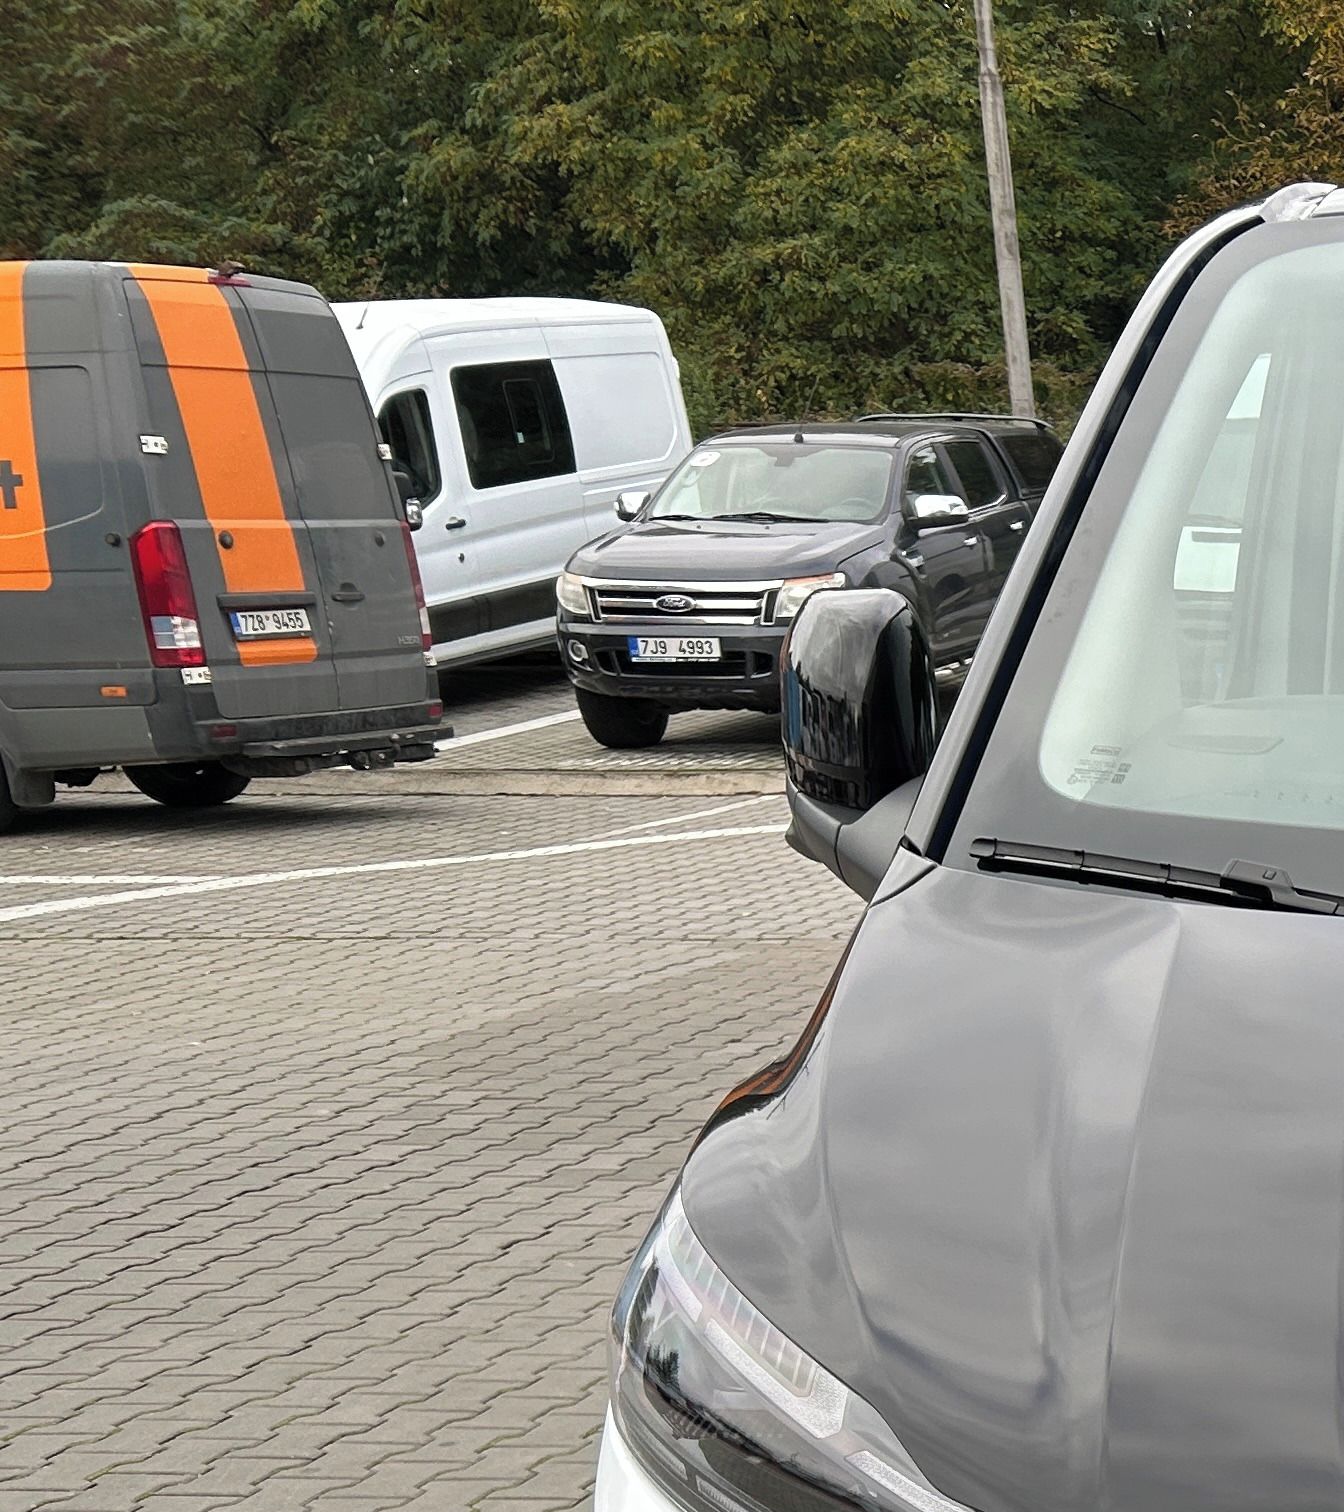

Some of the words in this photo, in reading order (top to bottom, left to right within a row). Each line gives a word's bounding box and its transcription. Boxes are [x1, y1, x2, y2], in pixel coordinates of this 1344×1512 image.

[240, 614, 266, 632] 7Z8
[272, 611, 305, 630] 9455
[640, 640, 668, 655] 7J9
[678, 640, 714, 655] 4993
